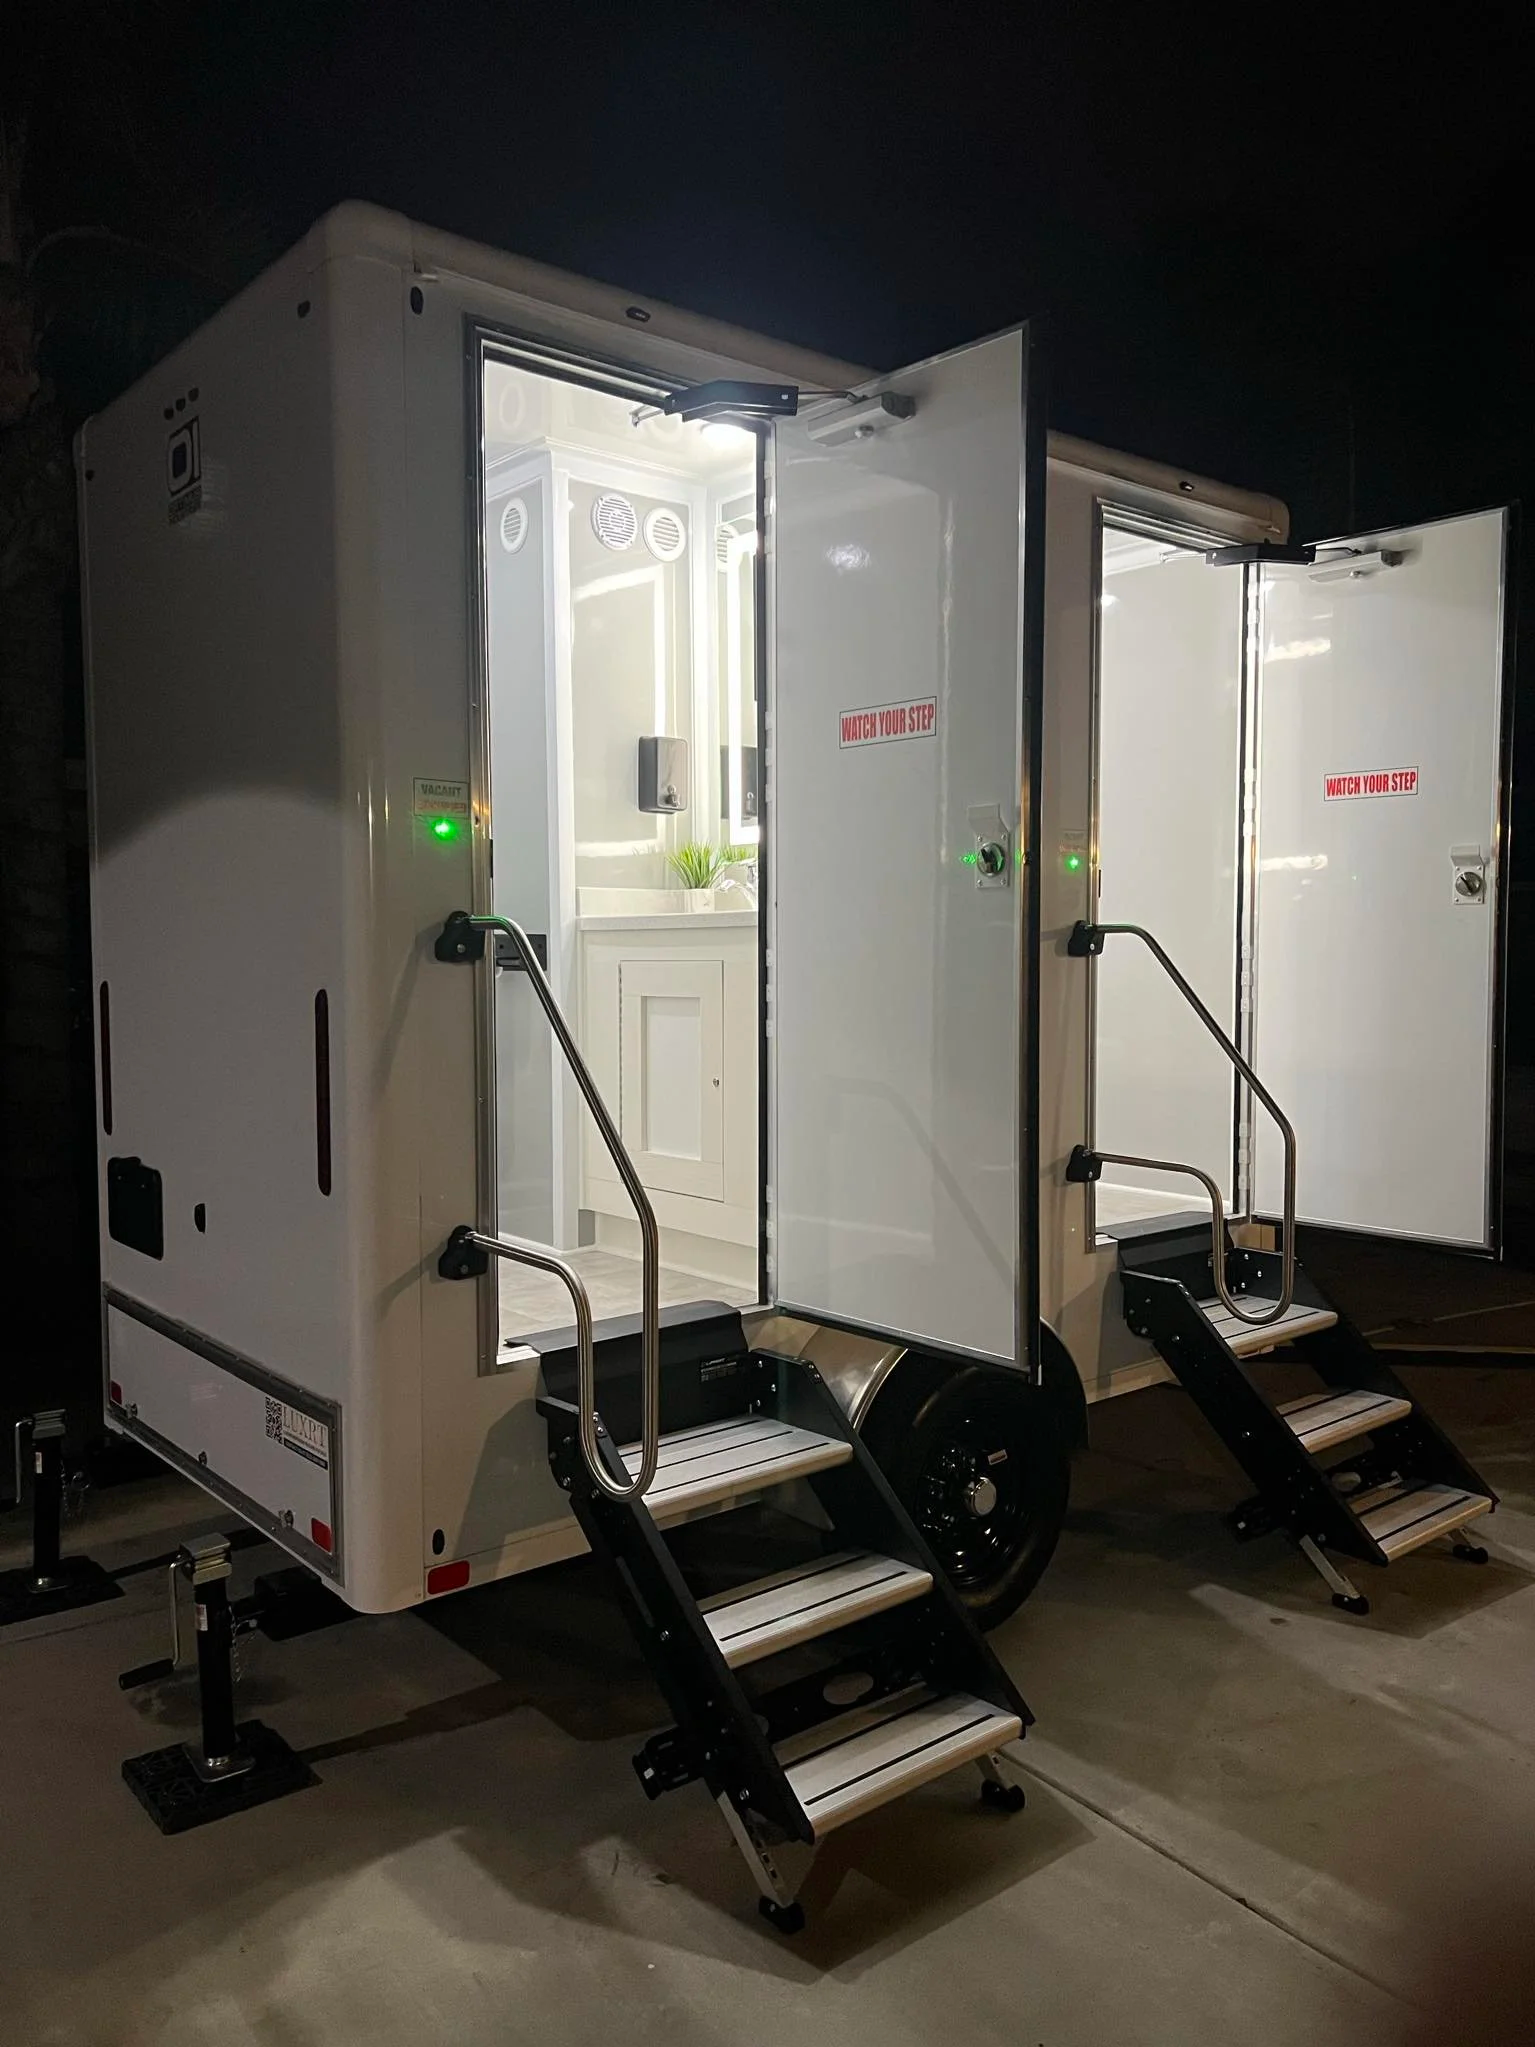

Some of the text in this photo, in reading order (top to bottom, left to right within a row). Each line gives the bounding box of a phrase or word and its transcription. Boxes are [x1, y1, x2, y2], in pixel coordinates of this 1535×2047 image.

[841, 703, 934, 742] WATCH YOUR STEP
[421, 784, 461, 798] VACANT
[1326, 771, 1416, 797] WATCH YOUR STEP
